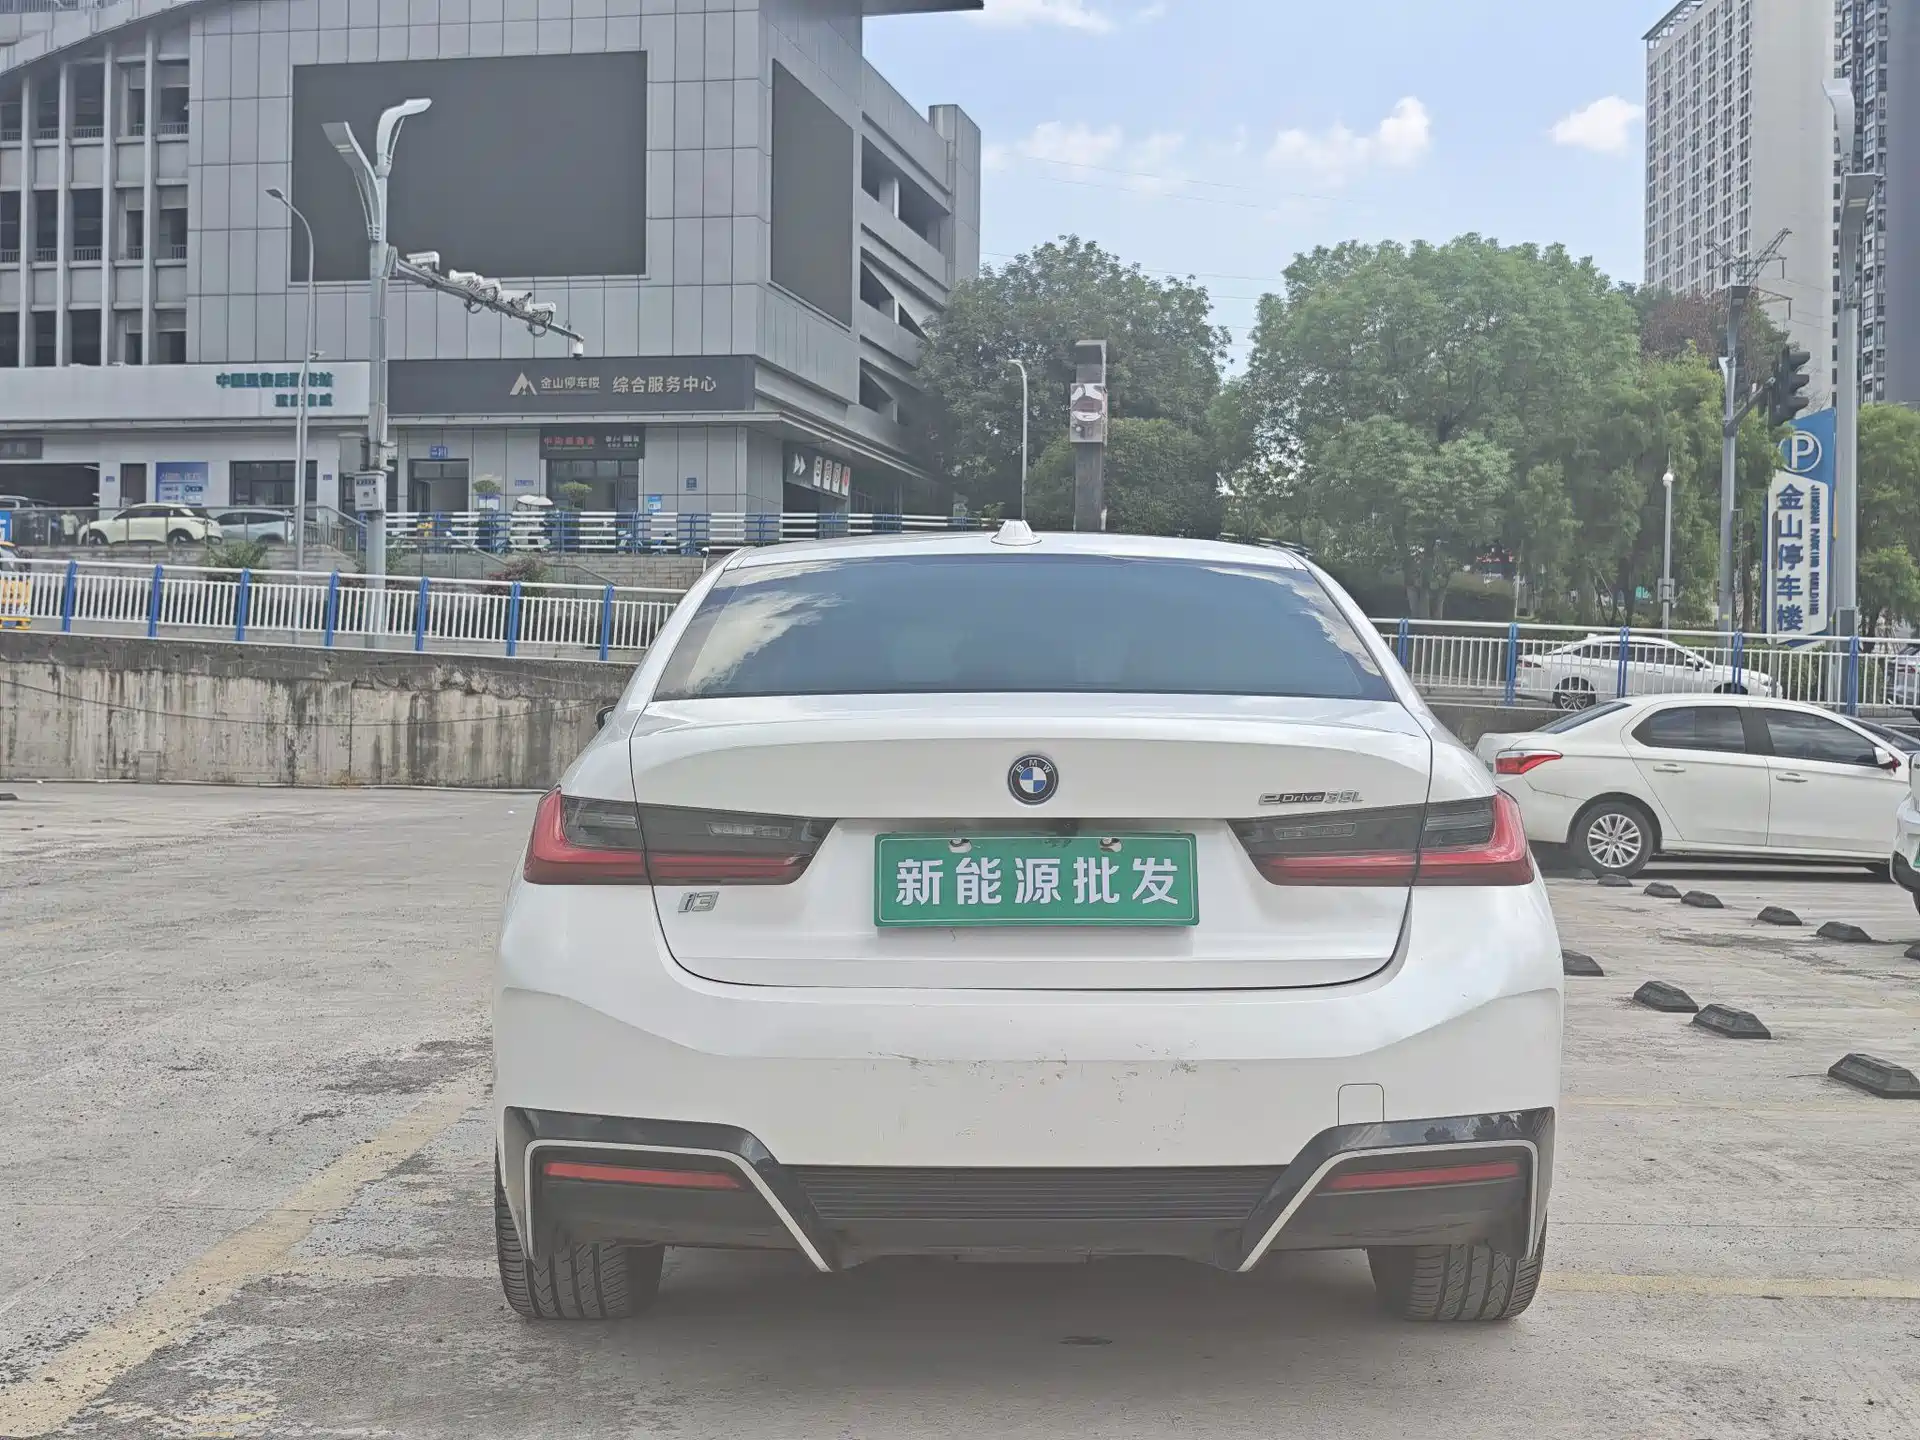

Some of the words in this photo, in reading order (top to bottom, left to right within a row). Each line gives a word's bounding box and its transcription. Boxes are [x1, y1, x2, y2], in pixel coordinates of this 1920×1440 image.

[612, 375, 717, 394] 综合服务中心
[1791, 435, 1815, 469] P
[1776, 483, 1804, 632] 金山停车楼
[895, 856, 1179, 906] 新能源批发
[678, 891, 720, 913] i3
